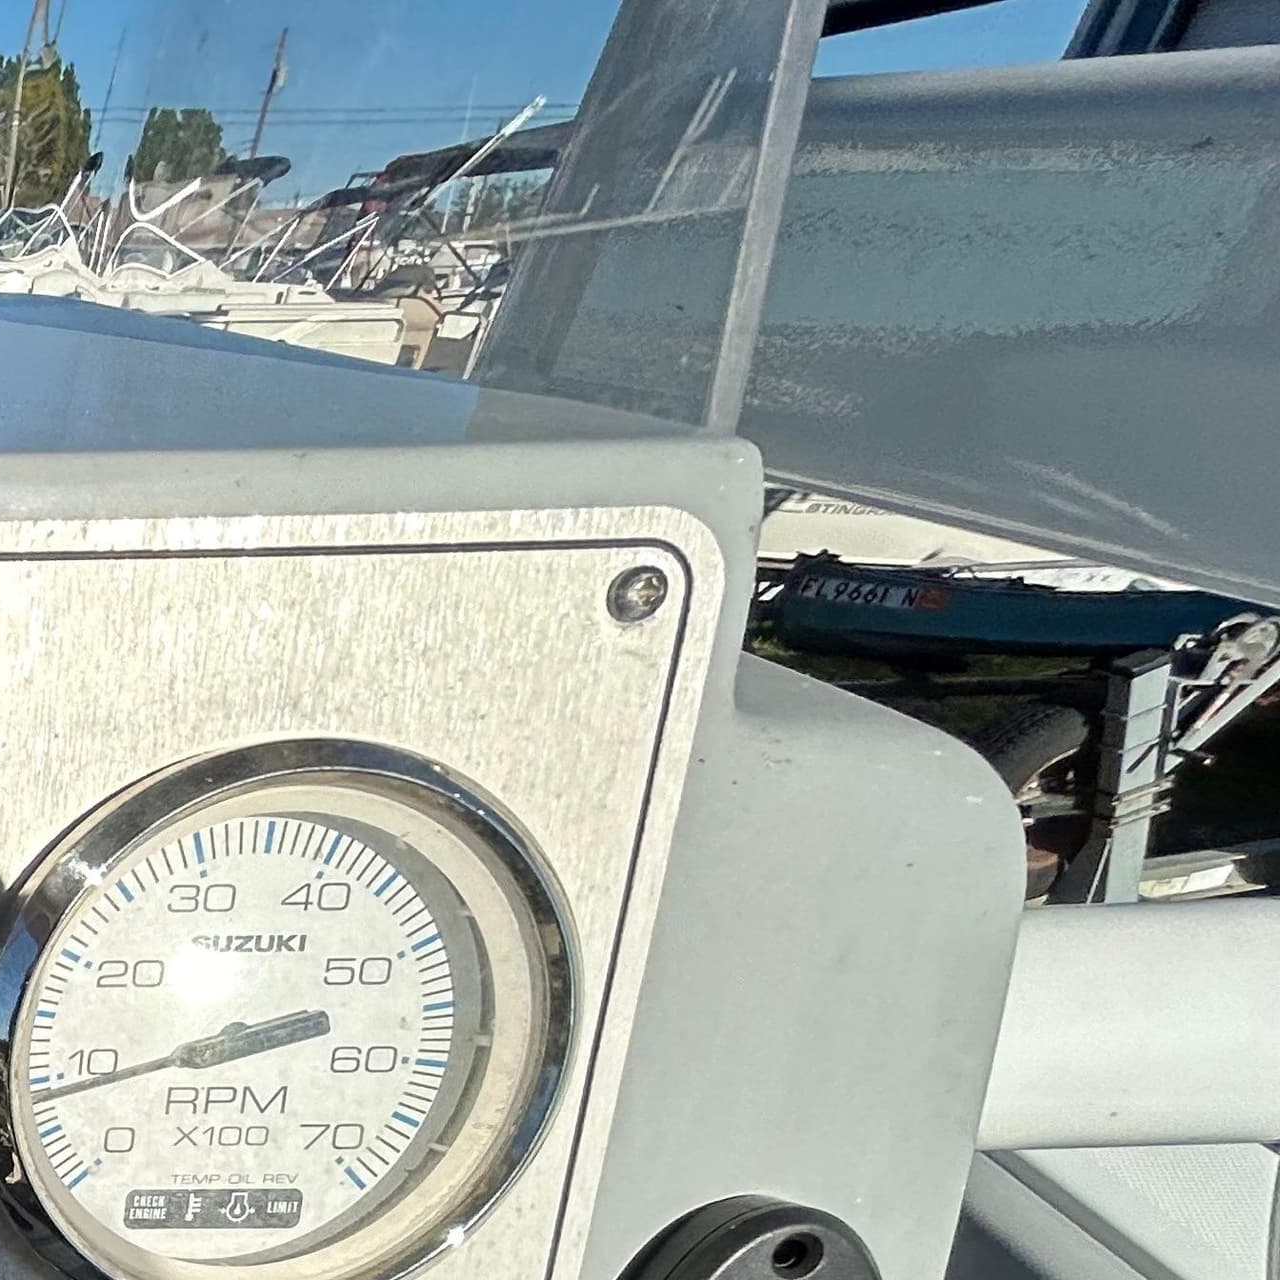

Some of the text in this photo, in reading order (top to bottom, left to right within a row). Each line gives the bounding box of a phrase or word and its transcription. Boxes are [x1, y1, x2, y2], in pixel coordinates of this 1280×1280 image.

[167, 883, 351, 913] 30 40
[191, 934, 308, 952] SUZUKI
[96, 960, 165, 988] 20
[324, 958, 392, 985] 50
[68, 1049, 119, 1076] 10
[330, 1046, 398, 1073] 60
[165, 1086, 287, 1114] RPM
[104, 1127, 135, 1153] 0
[173, 1126, 270, 1147] X100
[301, 1124, 364, 1150] 70
[172, 1173, 299, 1184] TEMP OIL REV
[129, 1208, 167, 1220] ENGINE
[133, 1196, 166, 1208] CHECK
[267, 1201, 299, 1214] LIMIT
